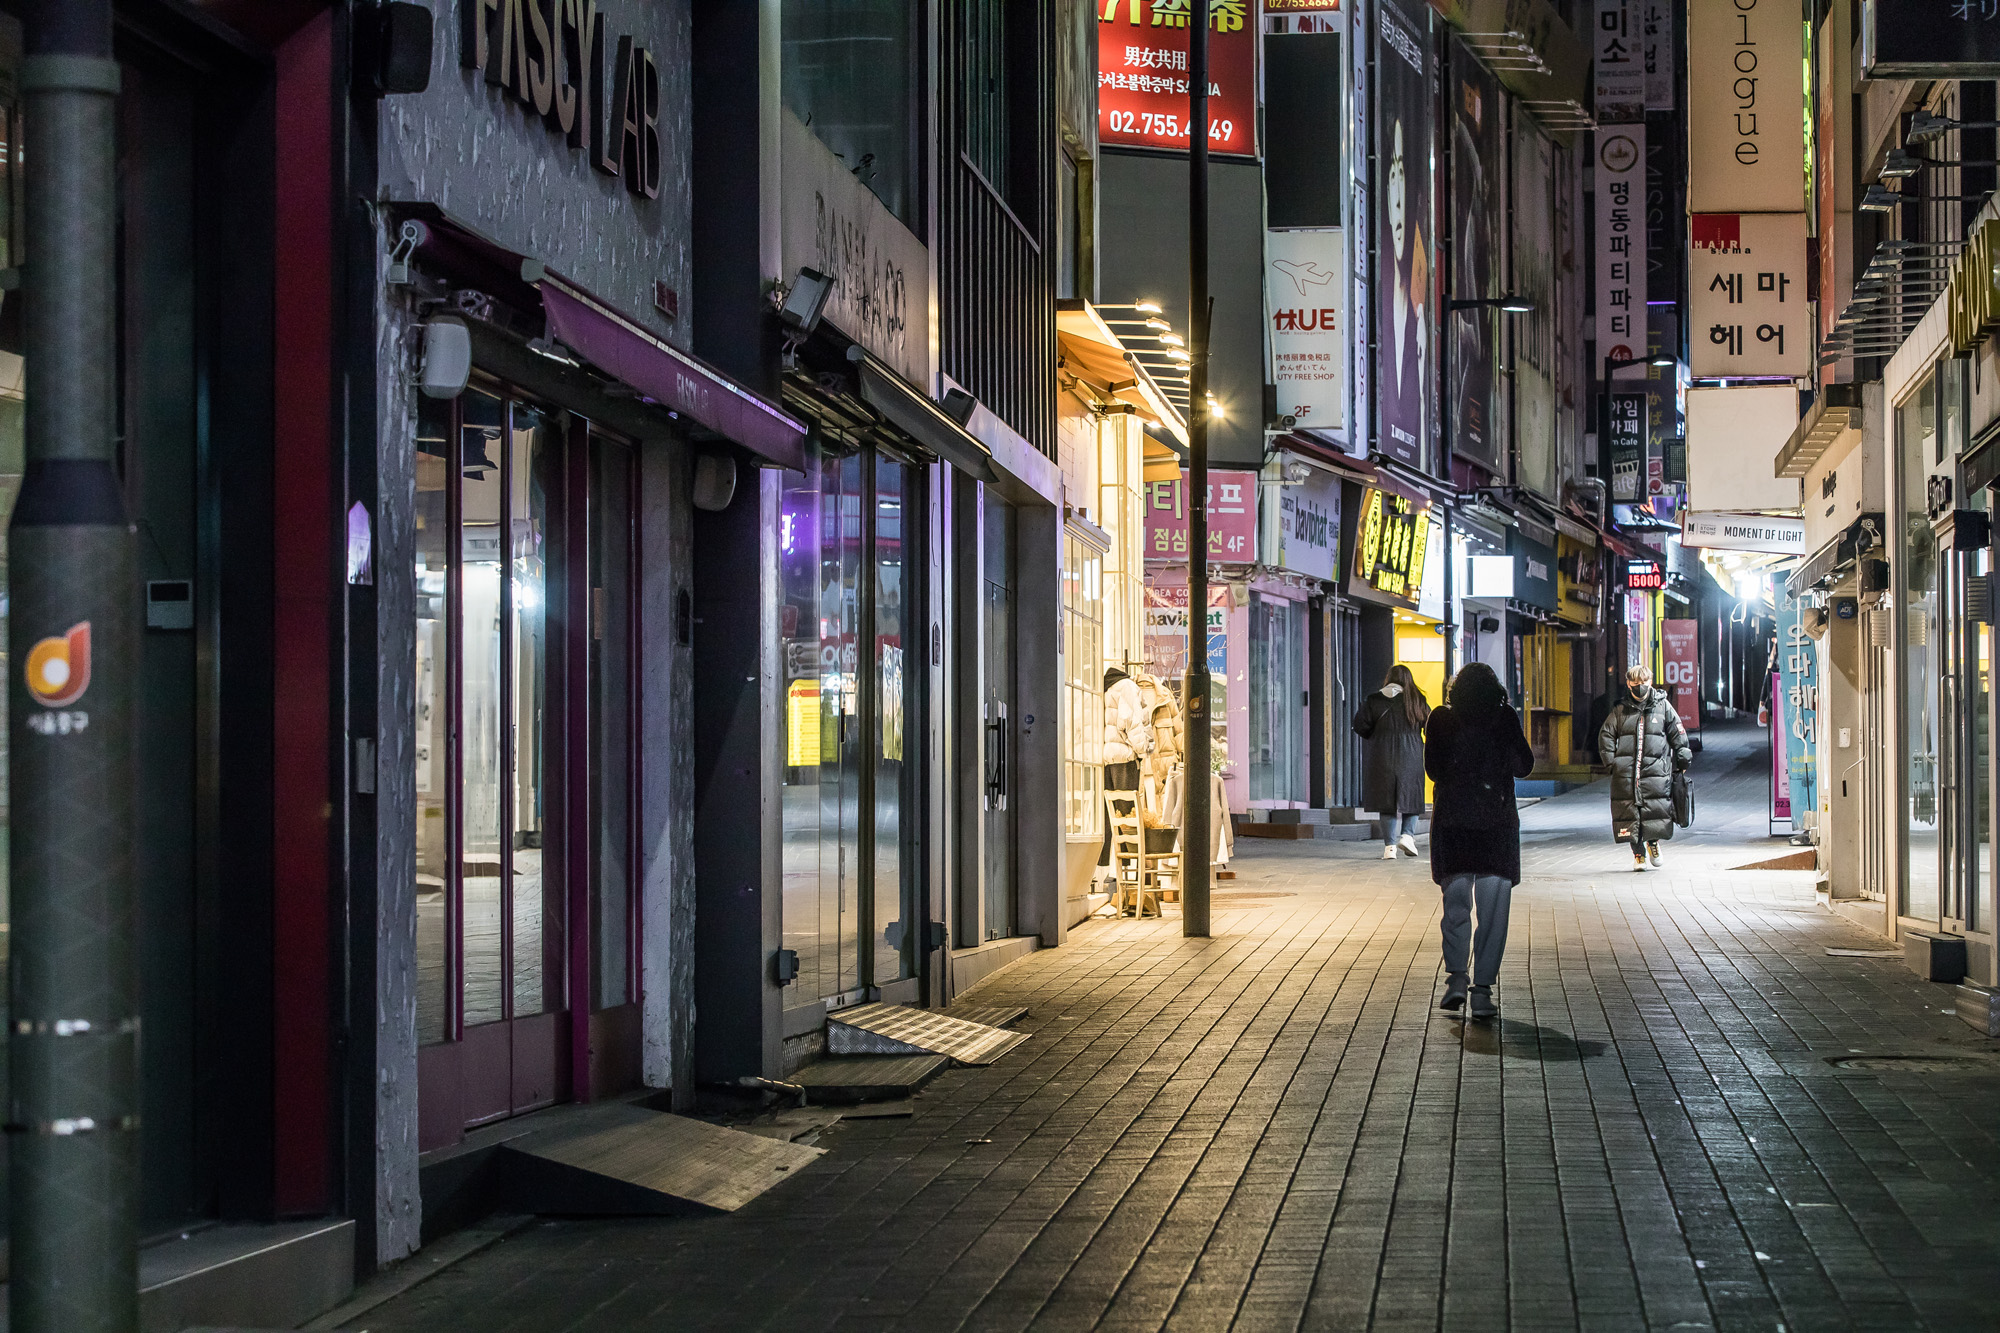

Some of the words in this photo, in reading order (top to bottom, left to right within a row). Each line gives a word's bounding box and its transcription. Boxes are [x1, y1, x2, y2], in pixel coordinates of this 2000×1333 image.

[1124, 45, 1187, 70] 男女共用
[1109, 109, 1233, 142] 02.755.449
[1694, 240, 1739, 249] HAIR
[1609, 181, 1631, 337] 명동파티파티
[1709, 273, 1791, 304] 세마
[1709, 324, 1784, 355] 헤어
[1294, 405, 1311, 417] 2F
[1620, 438, 1638, 446] Cafe
[1295, 495, 1327, 549] baviphat
[1227, 536, 1245, 552] 4F
[1724, 525, 1763, 540] MOMENT
[1765, 529, 1776, 540] OF
[1778, 530, 1803, 542] LIGHT
[1629, 574, 1661, 588] 15000
